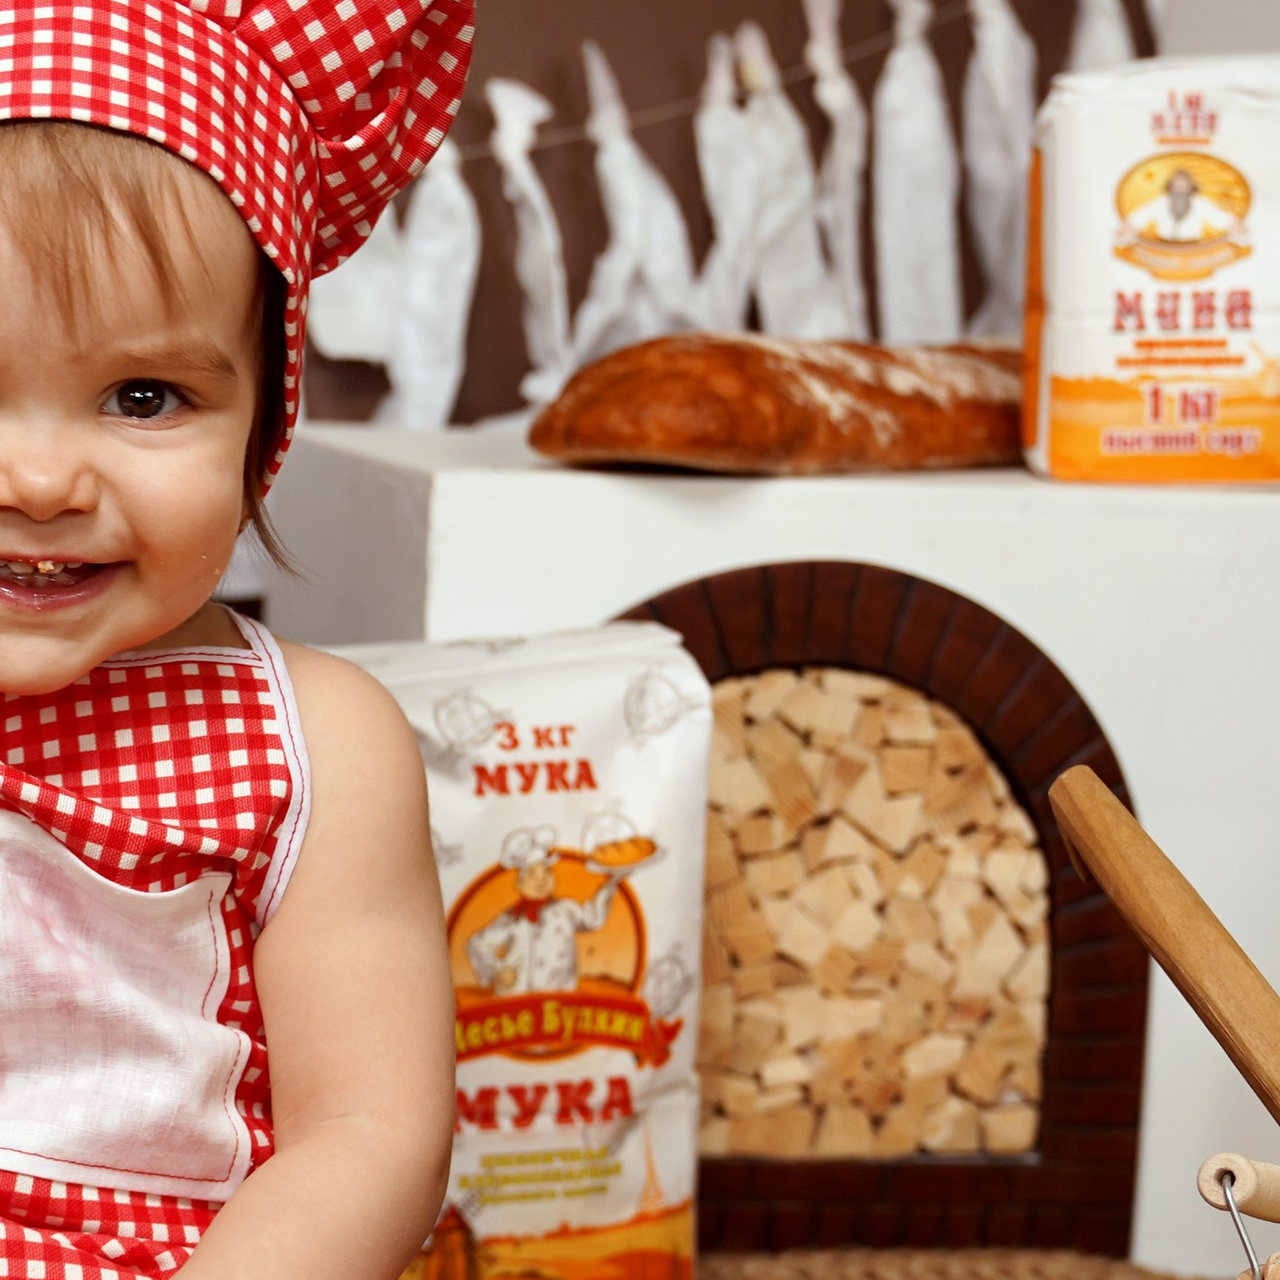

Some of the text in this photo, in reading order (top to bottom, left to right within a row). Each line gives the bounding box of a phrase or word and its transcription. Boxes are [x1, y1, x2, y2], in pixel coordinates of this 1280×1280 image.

[494, 721, 519, 751] 3
[473, 757, 598, 797] МУКА
[542, 1000, 643, 1043] Булкин
[455, 1076, 634, 1134] МУКА
